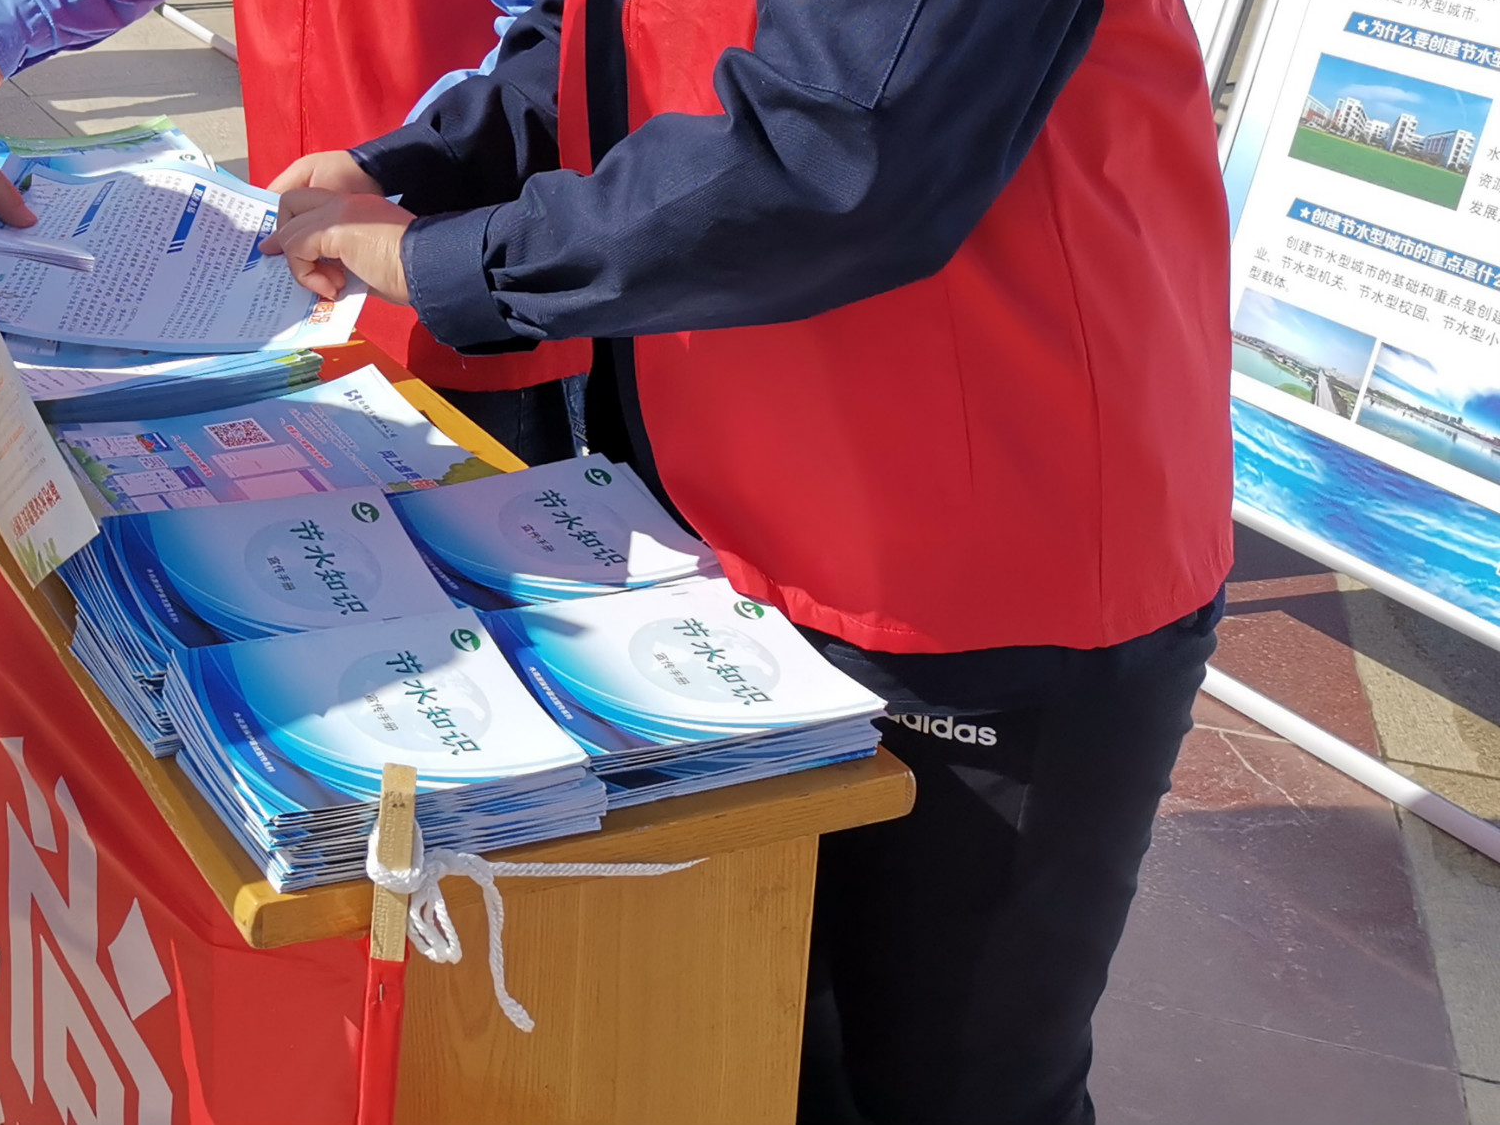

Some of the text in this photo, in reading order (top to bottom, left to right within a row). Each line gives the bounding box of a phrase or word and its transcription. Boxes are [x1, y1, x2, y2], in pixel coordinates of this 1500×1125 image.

[534, 489, 627, 567] 节水知识
[266, 555, 296, 591] 宣传手册
[289, 519, 369, 616] 节水知识
[653, 651, 690, 686] 宣传手册
[673, 617, 773, 706] 节水知识
[365, 692, 399, 732] 宣传手册
[386, 650, 481, 756] 节水知识
[887, 713, 998, 747] didas
